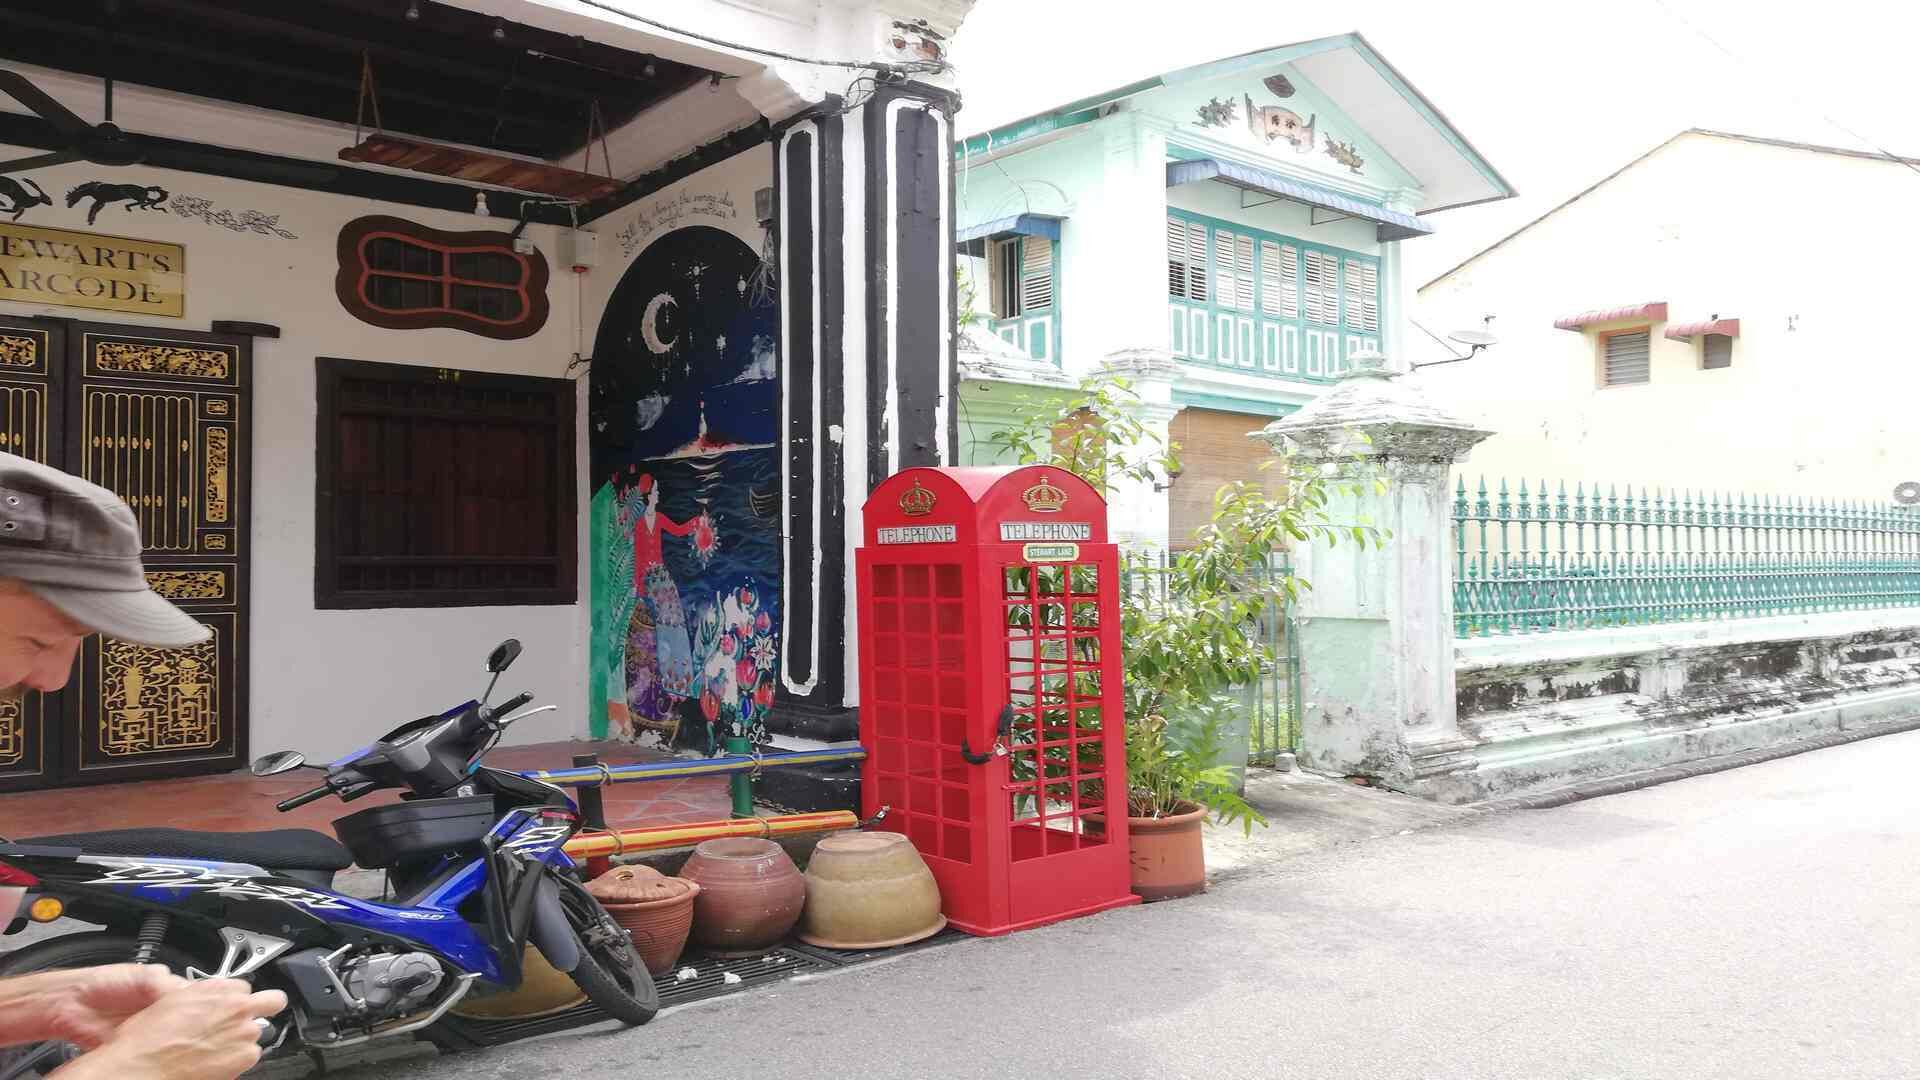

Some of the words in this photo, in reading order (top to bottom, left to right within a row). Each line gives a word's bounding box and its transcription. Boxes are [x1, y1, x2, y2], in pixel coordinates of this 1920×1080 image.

[0, 236, 170, 274] EWART'S
[879, 526, 953, 543] TELEPHONE
[1002, 524, 1089, 540] TELEPHONE
